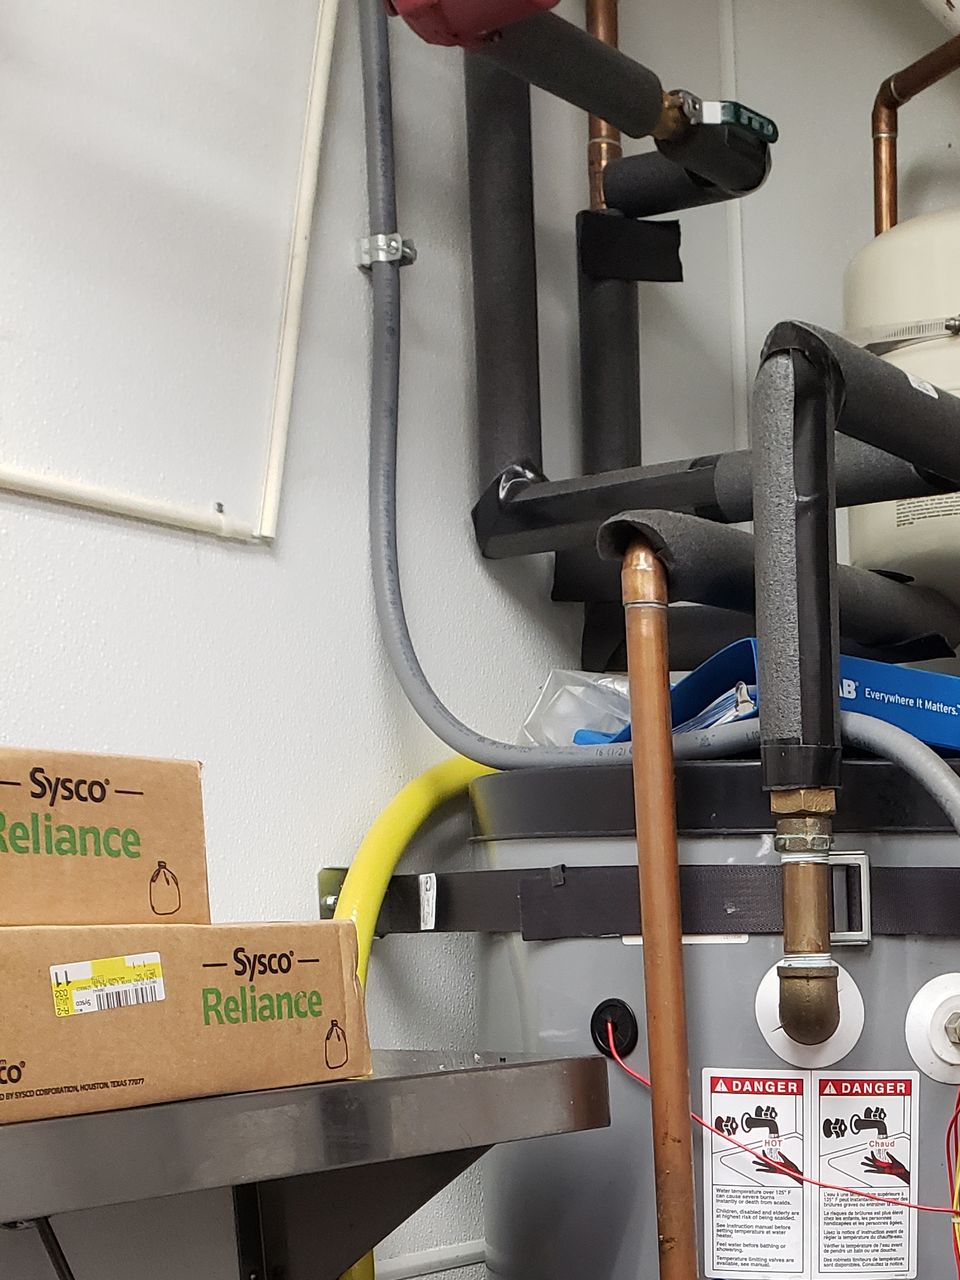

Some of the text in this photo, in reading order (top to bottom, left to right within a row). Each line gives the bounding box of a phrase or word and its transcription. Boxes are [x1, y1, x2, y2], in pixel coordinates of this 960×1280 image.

[865, 688, 914, 707] Everywhere
[916, 699, 923, 709] It
[202, 985, 323, 1026] Reliance
[5, 1091, 14, 1100] BY
[14, 1089, 35, 1099] SYSCO
[110, 1080, 127, 1089] TEXAS
[732, 1079, 798, 1093] DANGER
[841, 1082, 906, 1095] DANGER
[764, 1139, 783, 1148] HOT
[869, 1139, 895, 1148] Chaud
